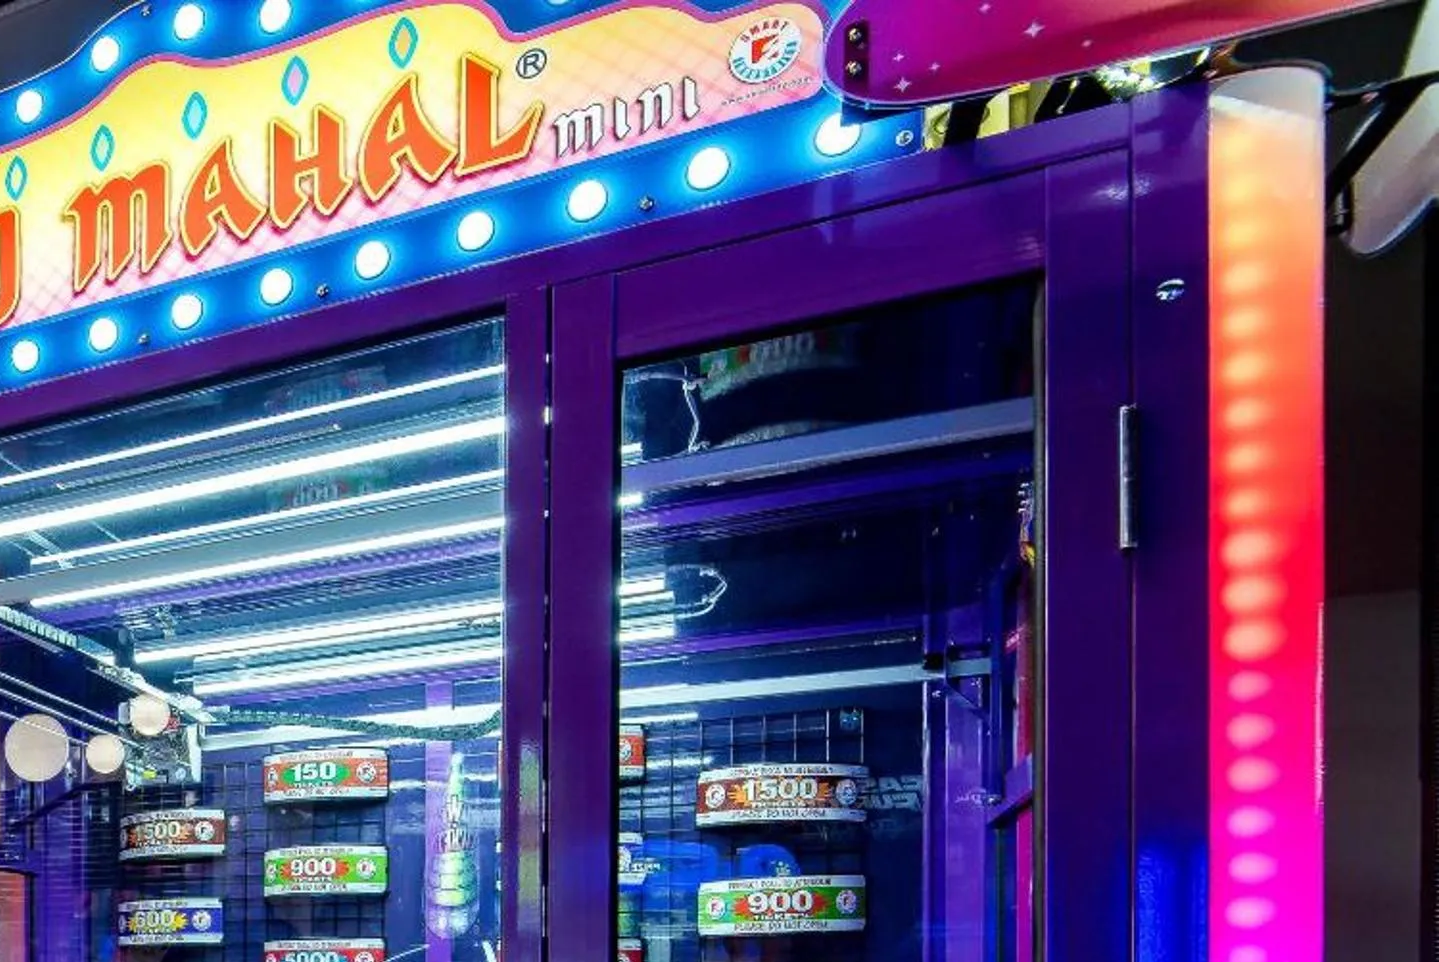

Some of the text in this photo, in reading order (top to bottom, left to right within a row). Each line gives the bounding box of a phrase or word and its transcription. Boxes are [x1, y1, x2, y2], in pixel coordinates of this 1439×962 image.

[68, 52, 545, 295] MAHAL
[551, 76, 702, 158] mini
[292, 761, 337, 781] 150
[745, 778, 818, 801] 1500
[748, 890, 813, 914] 900
